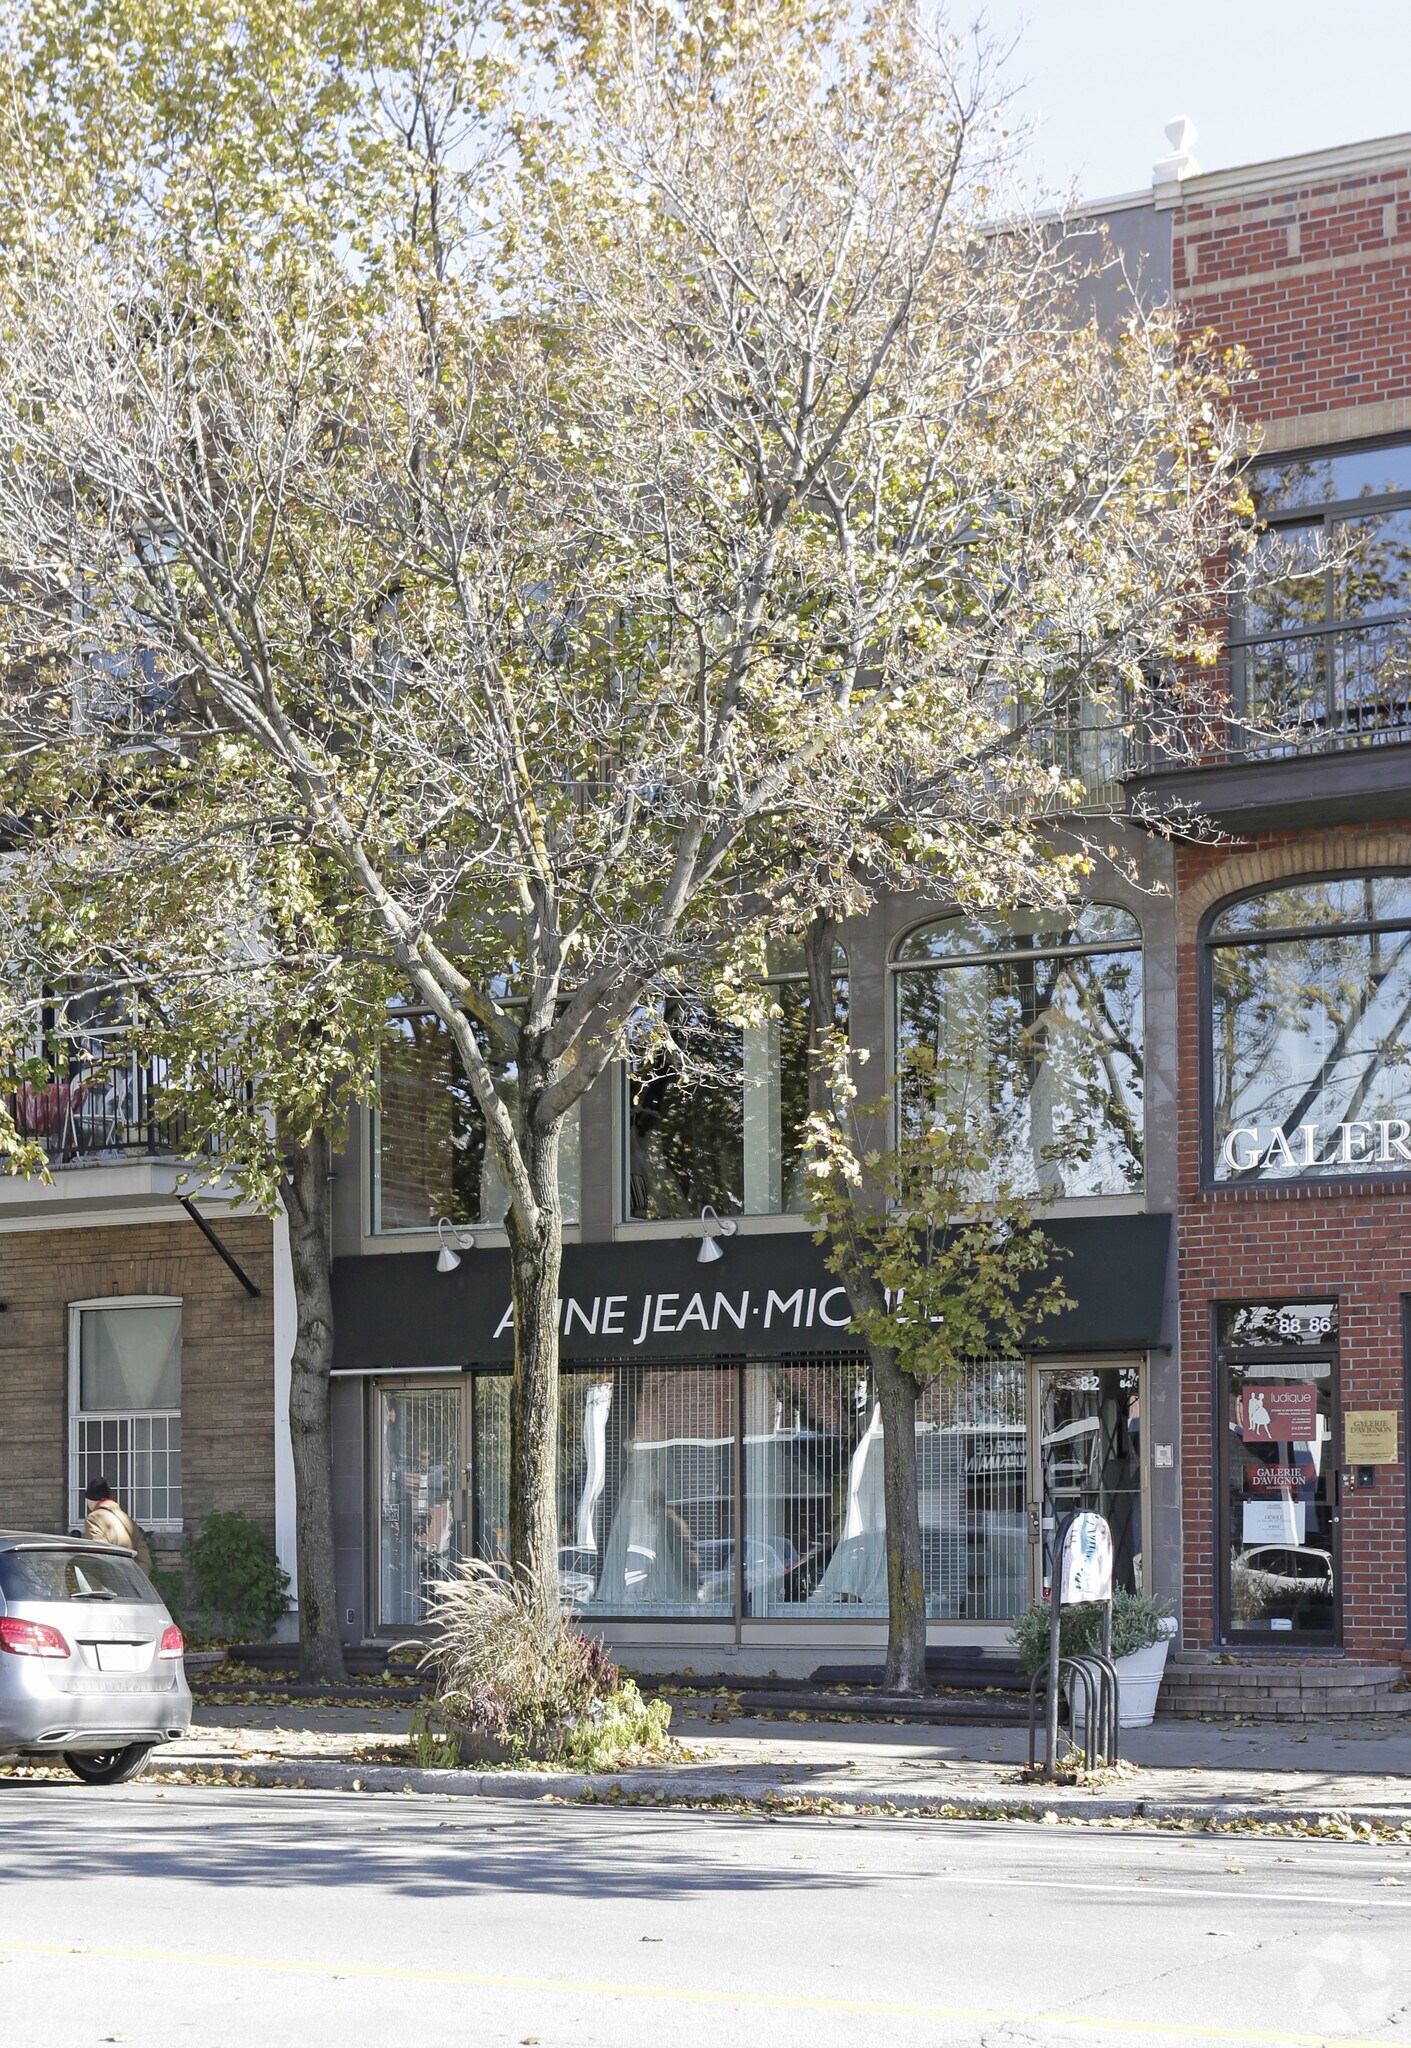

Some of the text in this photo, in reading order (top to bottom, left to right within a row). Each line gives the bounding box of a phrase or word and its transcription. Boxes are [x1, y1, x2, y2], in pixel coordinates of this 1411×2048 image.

[492, 1295, 628, 1339] ANE
[1279, 1317, 1331, 1334] 88 86
[1080, 1376, 1100, 1391] 82
[1270, 1392, 1311, 1404] ludique
[1353, 1420, 1388, 1428] GALERIE
[1350, 1426, 1392, 1434] D'AVIGNON
[1256, 1468, 1302, 1477] GALERIE
[1252, 1476, 1306, 1486] D'AVIGNON
